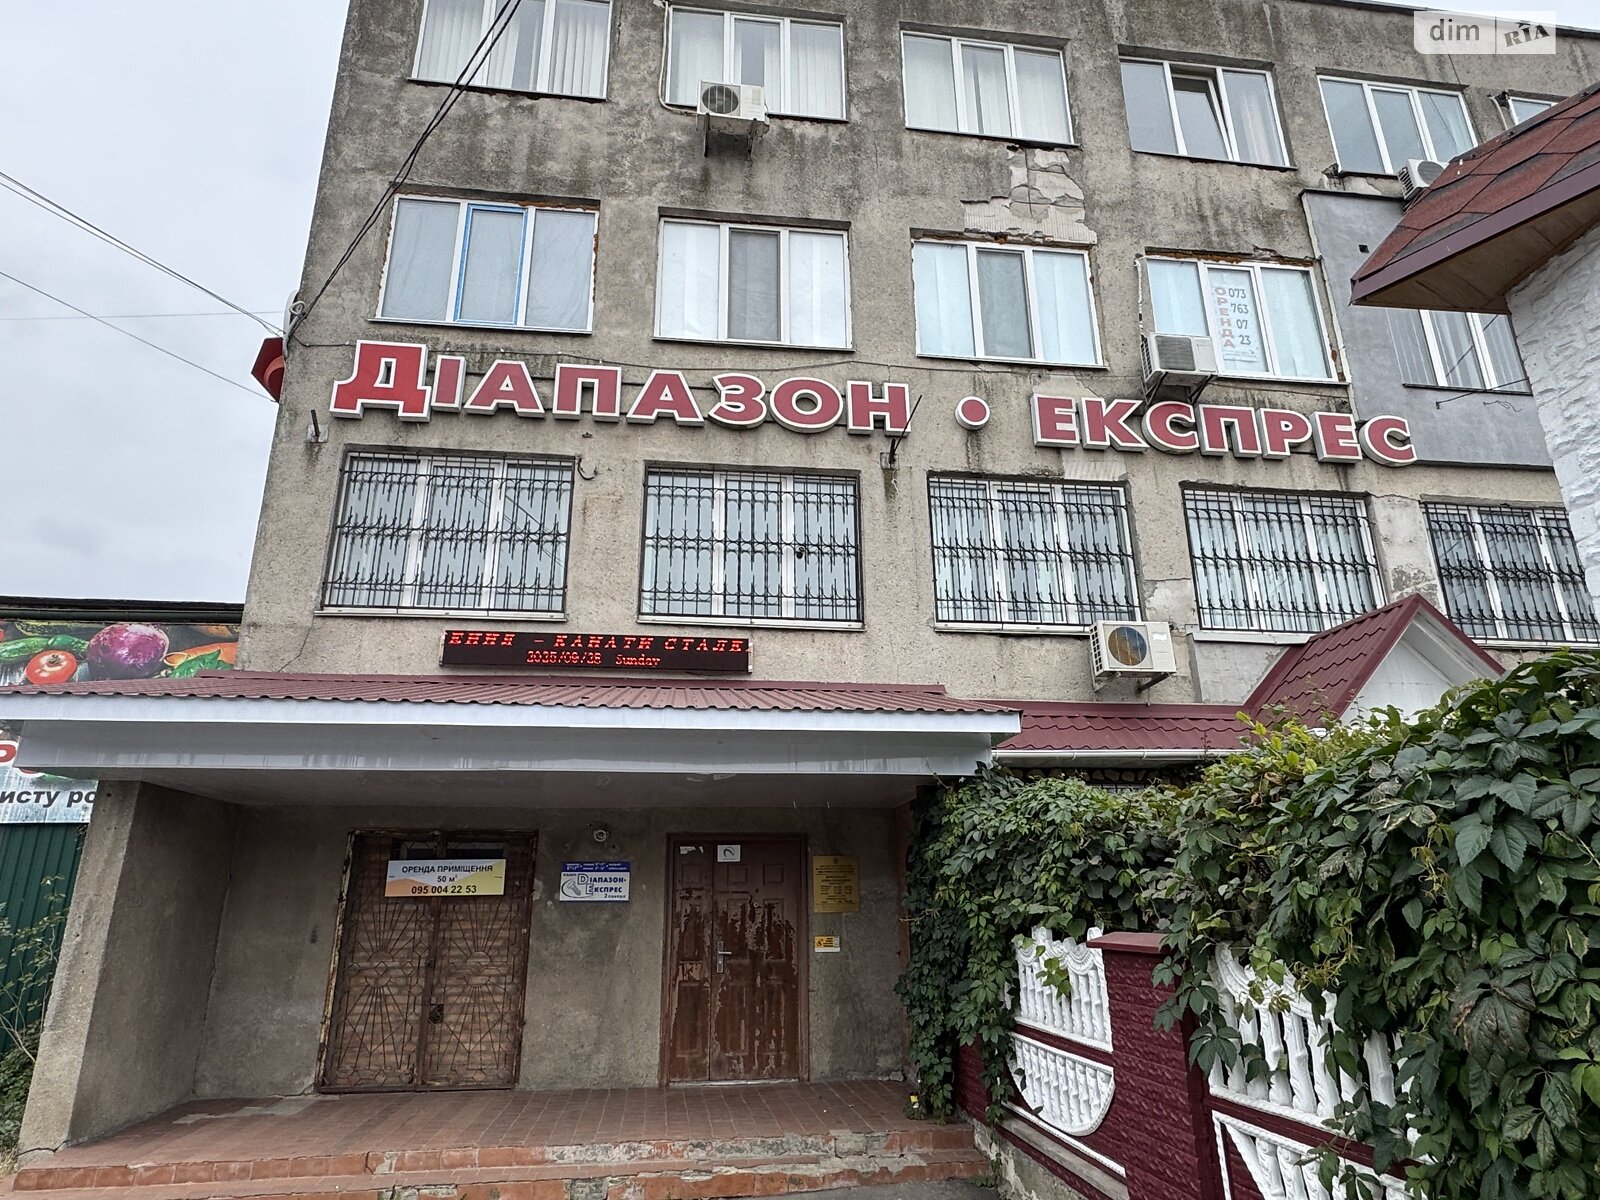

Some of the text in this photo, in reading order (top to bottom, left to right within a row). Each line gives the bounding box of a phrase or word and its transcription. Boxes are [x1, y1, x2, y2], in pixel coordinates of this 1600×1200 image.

[1228, 288, 1247, 299] 073
[1230, 303, 1249, 314] 763
[1236, 319, 1248, 330] 07
[1238, 334, 1251, 346] 23
[329, 339, 911, 437] ДІАПАЗОН
[1033, 393, 1417, 467] ЕКСПРЕС
[401, 864, 493, 874] ОРЕНДА ПРИМІЩЕННЯ
[437, 875, 447, 883] 50
[411, 885, 477, 895] 095 004 22 53
